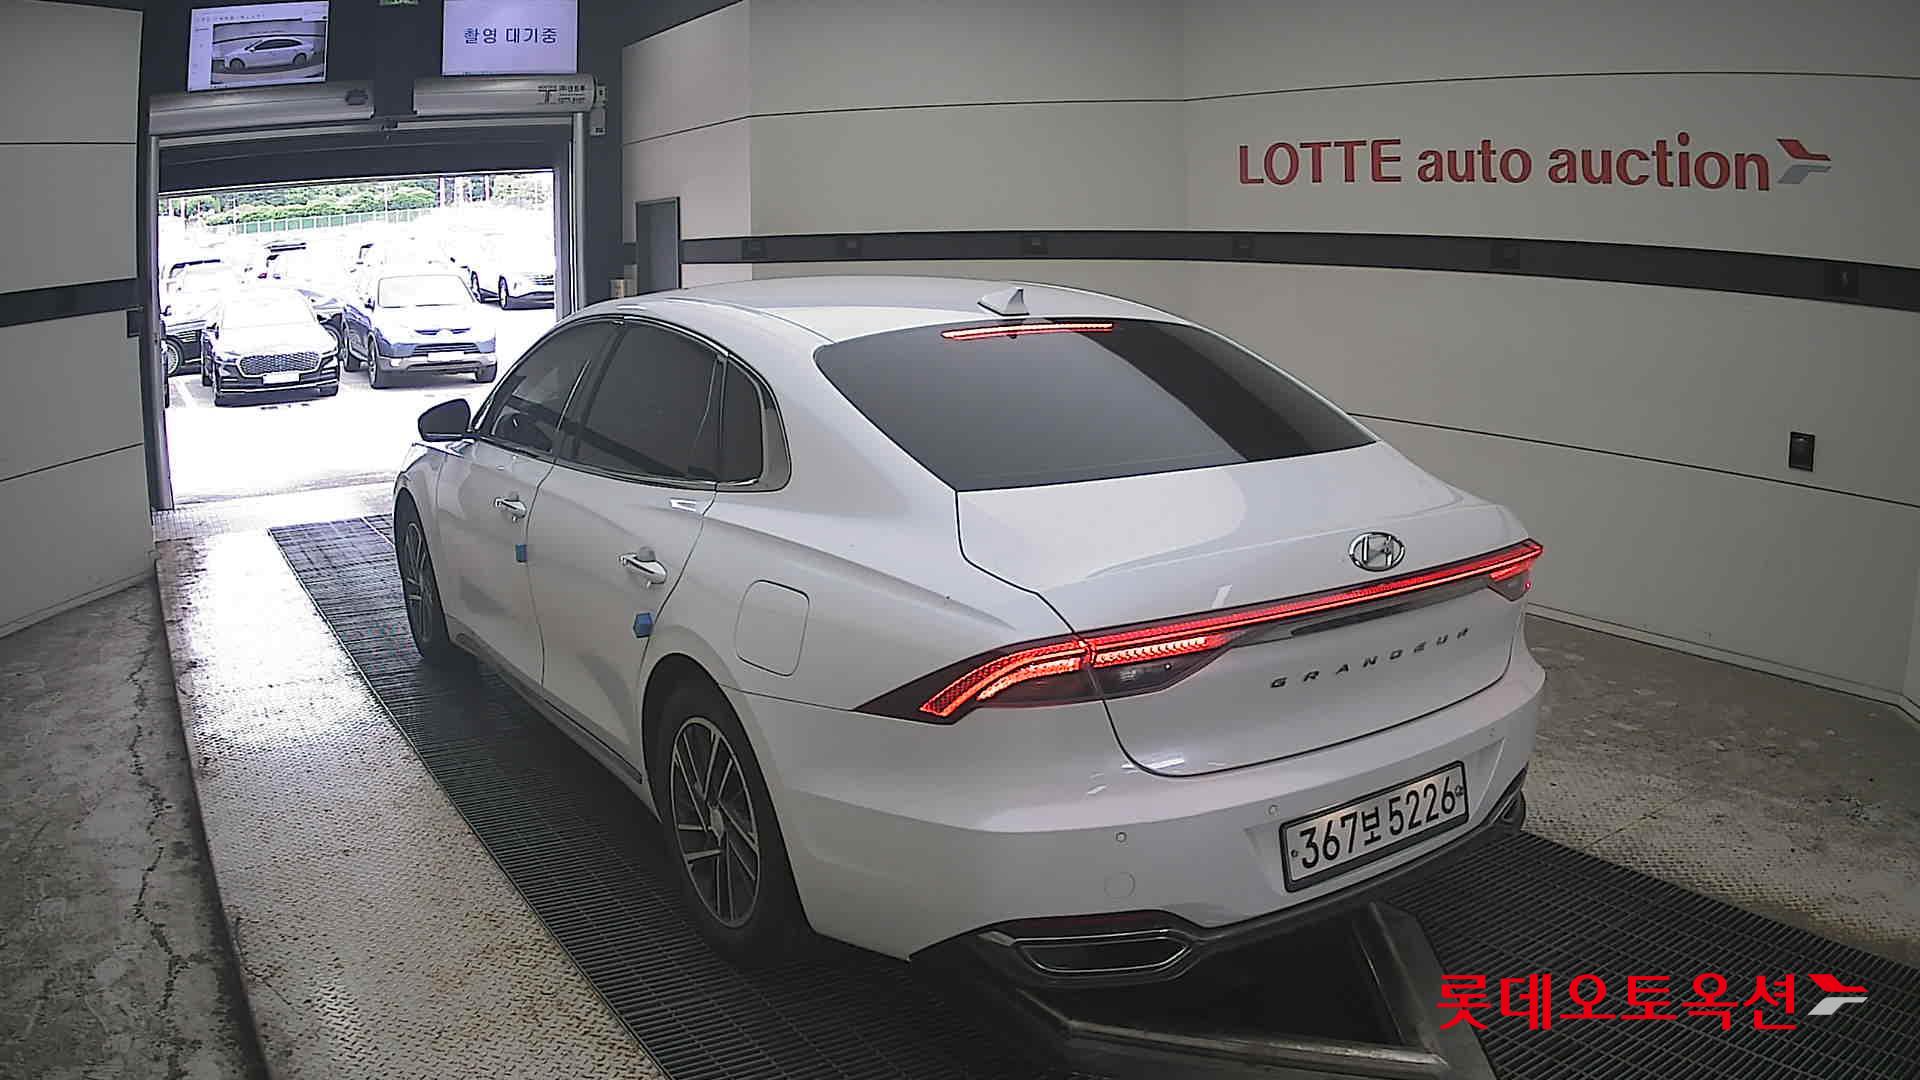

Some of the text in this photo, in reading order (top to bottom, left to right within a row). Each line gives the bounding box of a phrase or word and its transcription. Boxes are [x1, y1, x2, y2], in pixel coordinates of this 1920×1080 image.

[463, 27, 557, 44] 촬영 대기중
[1239, 132, 1770, 191] LOTTE auto auction
[1270, 627, 1469, 689] GRANDEUR
